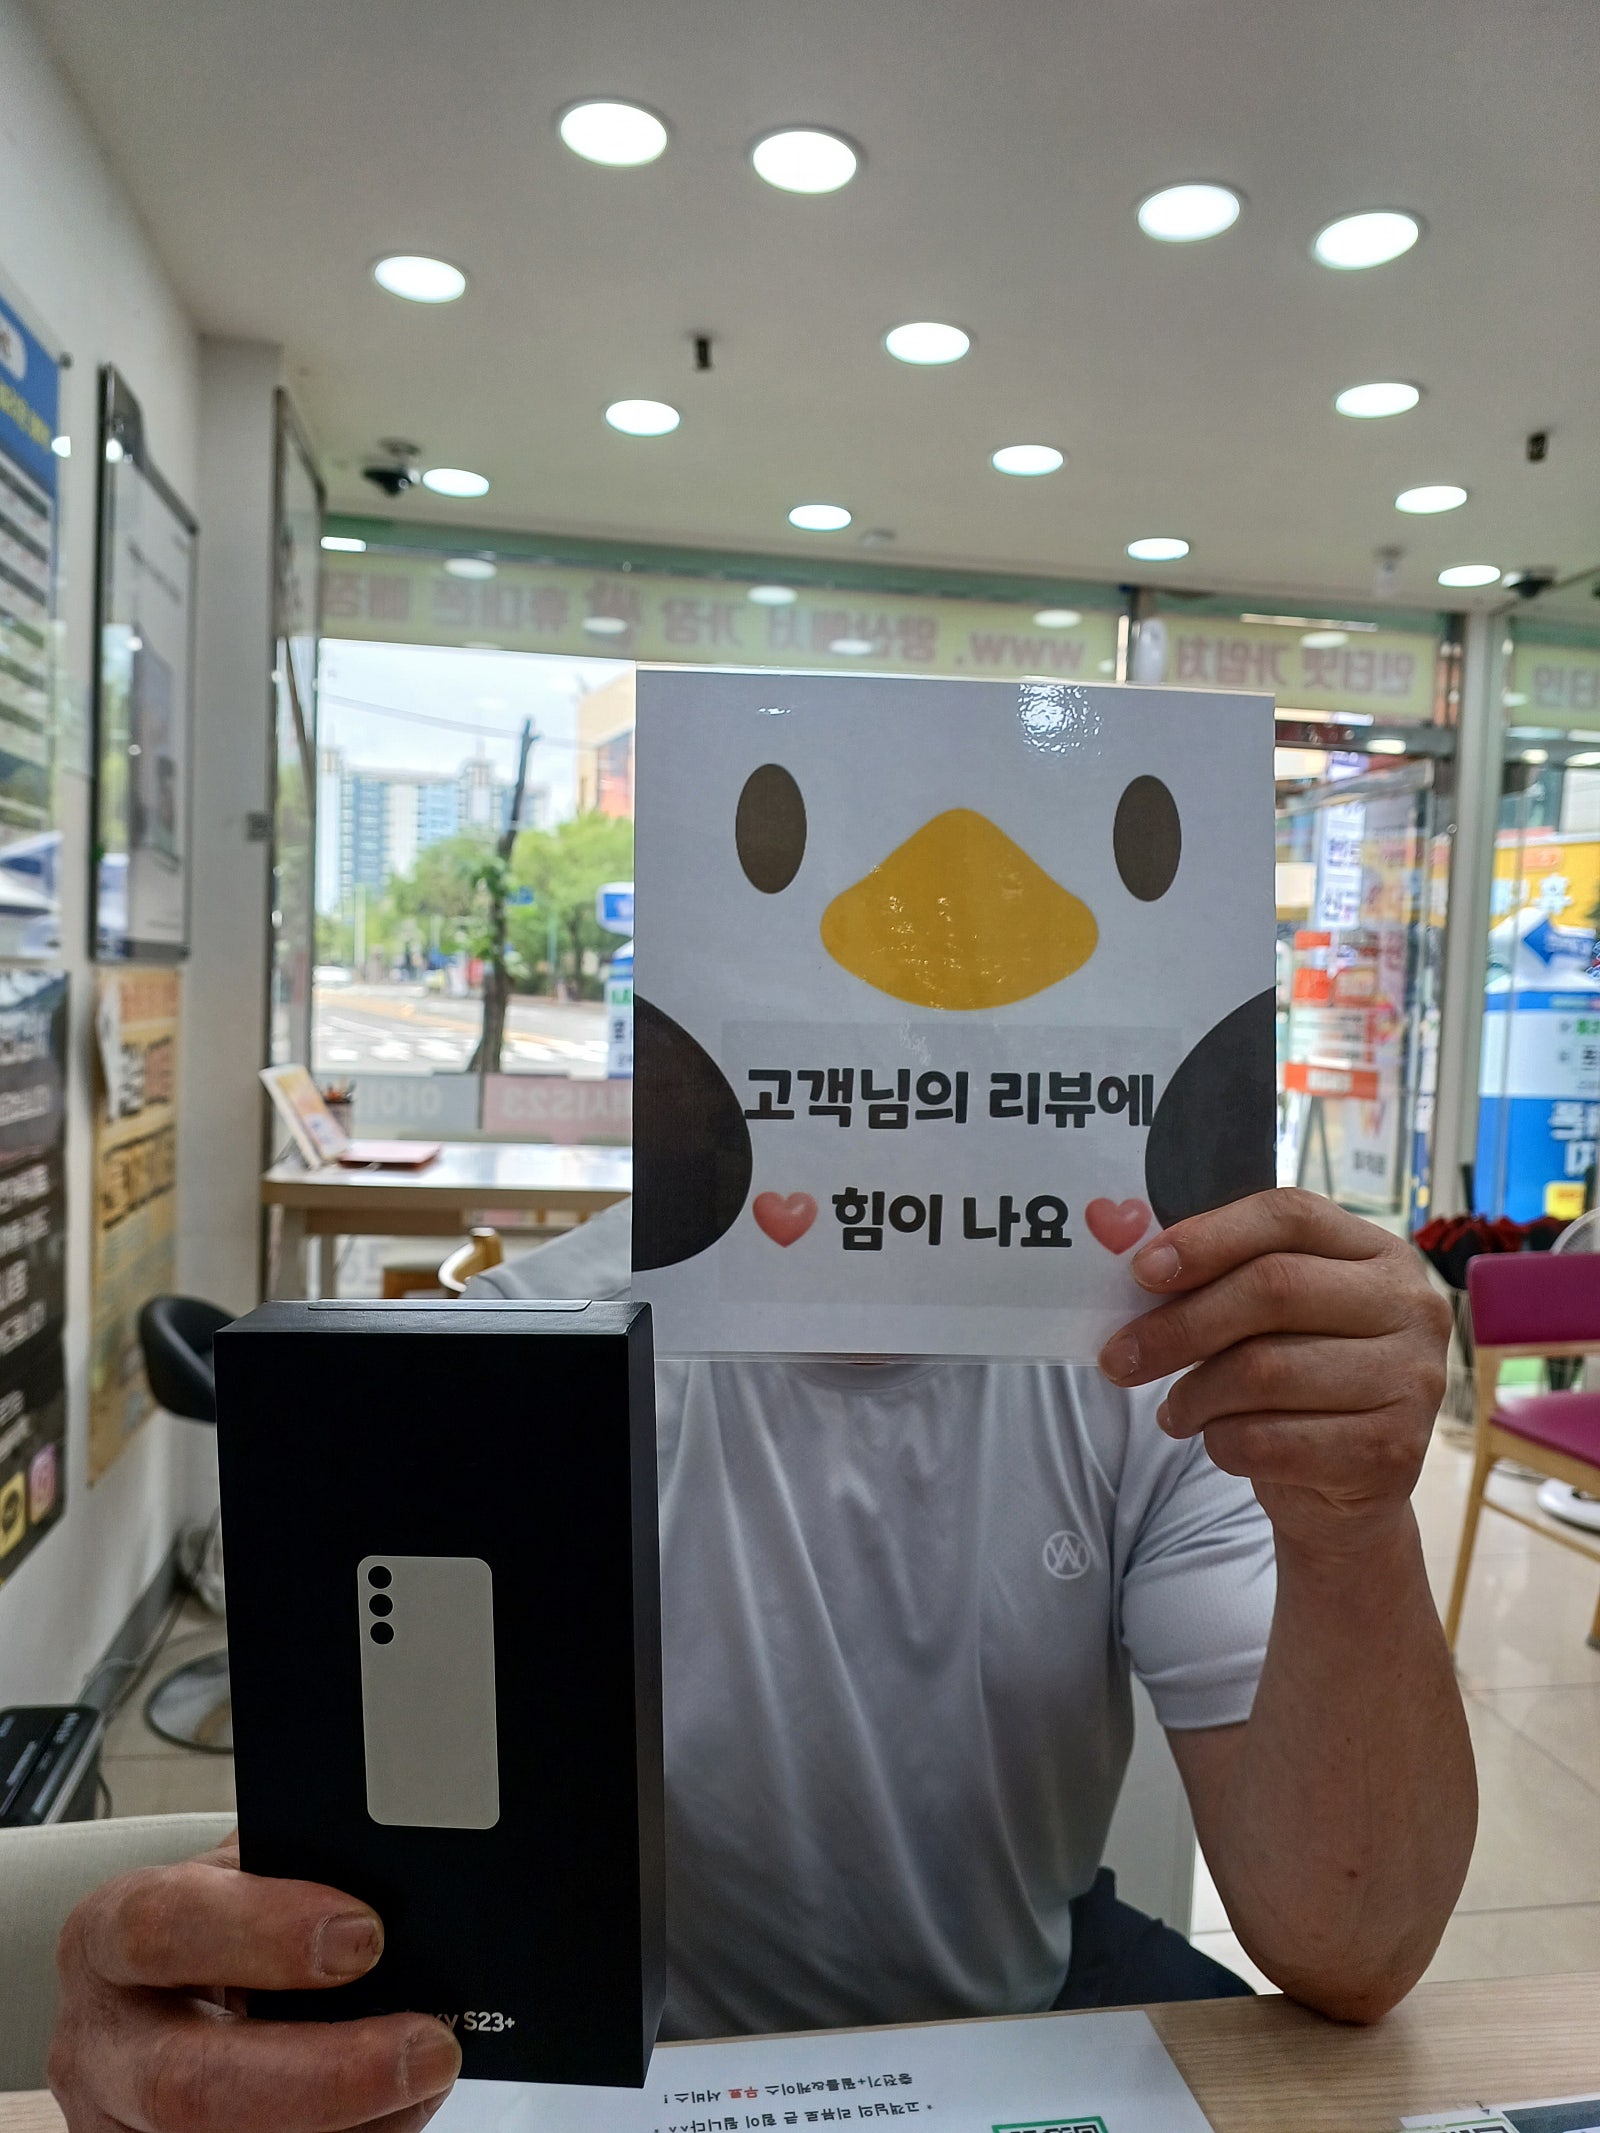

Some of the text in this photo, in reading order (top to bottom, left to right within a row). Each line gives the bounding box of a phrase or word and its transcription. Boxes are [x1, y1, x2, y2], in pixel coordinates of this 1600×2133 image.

[744, 1066, 1156, 1130] 고객님의 리뷰에
[831, 1186, 1073, 1251] 힘이 나요
[463, 2010, 516, 2032] S23+
[674, 2089, 721, 2105] 서비스
[728, 2086, 759, 2100] 무료
[804, 2107, 851, 2123] 리뷰로
[858, 2101, 920, 2118] 고객님의
[745, 2113, 777, 2128] 힘이
[783, 2111, 798, 2125] 큰
